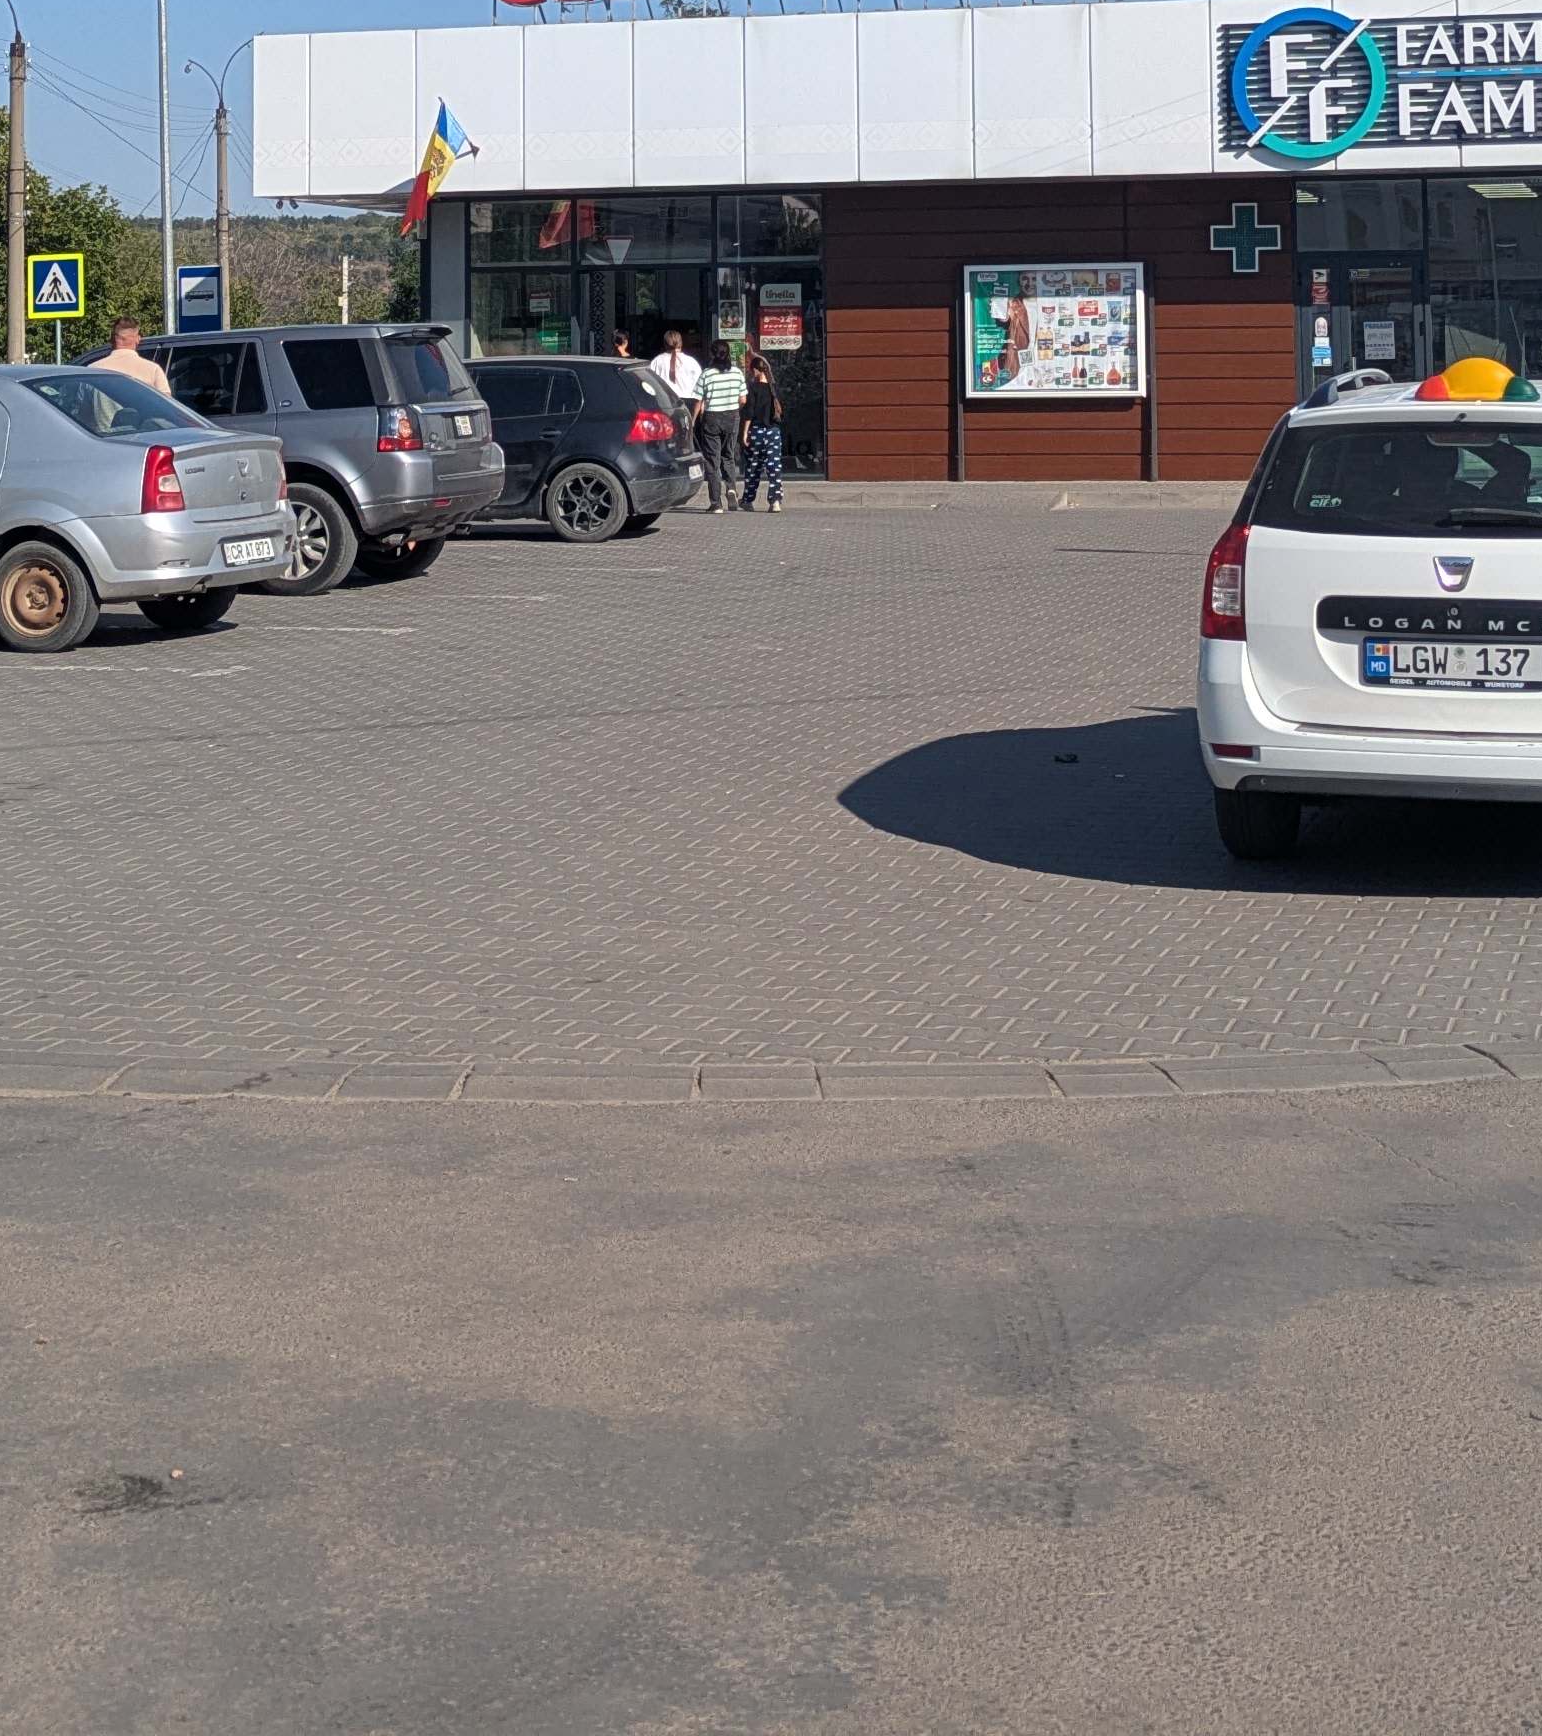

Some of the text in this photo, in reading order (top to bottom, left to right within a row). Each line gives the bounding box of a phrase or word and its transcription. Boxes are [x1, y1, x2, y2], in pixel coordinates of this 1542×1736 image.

[1343, 616, 1461, 630] LOGAN
[1370, 645, 1530, 677] MD LGW 137
[1426, 679, 1472, 687] AUTOMOBILE
